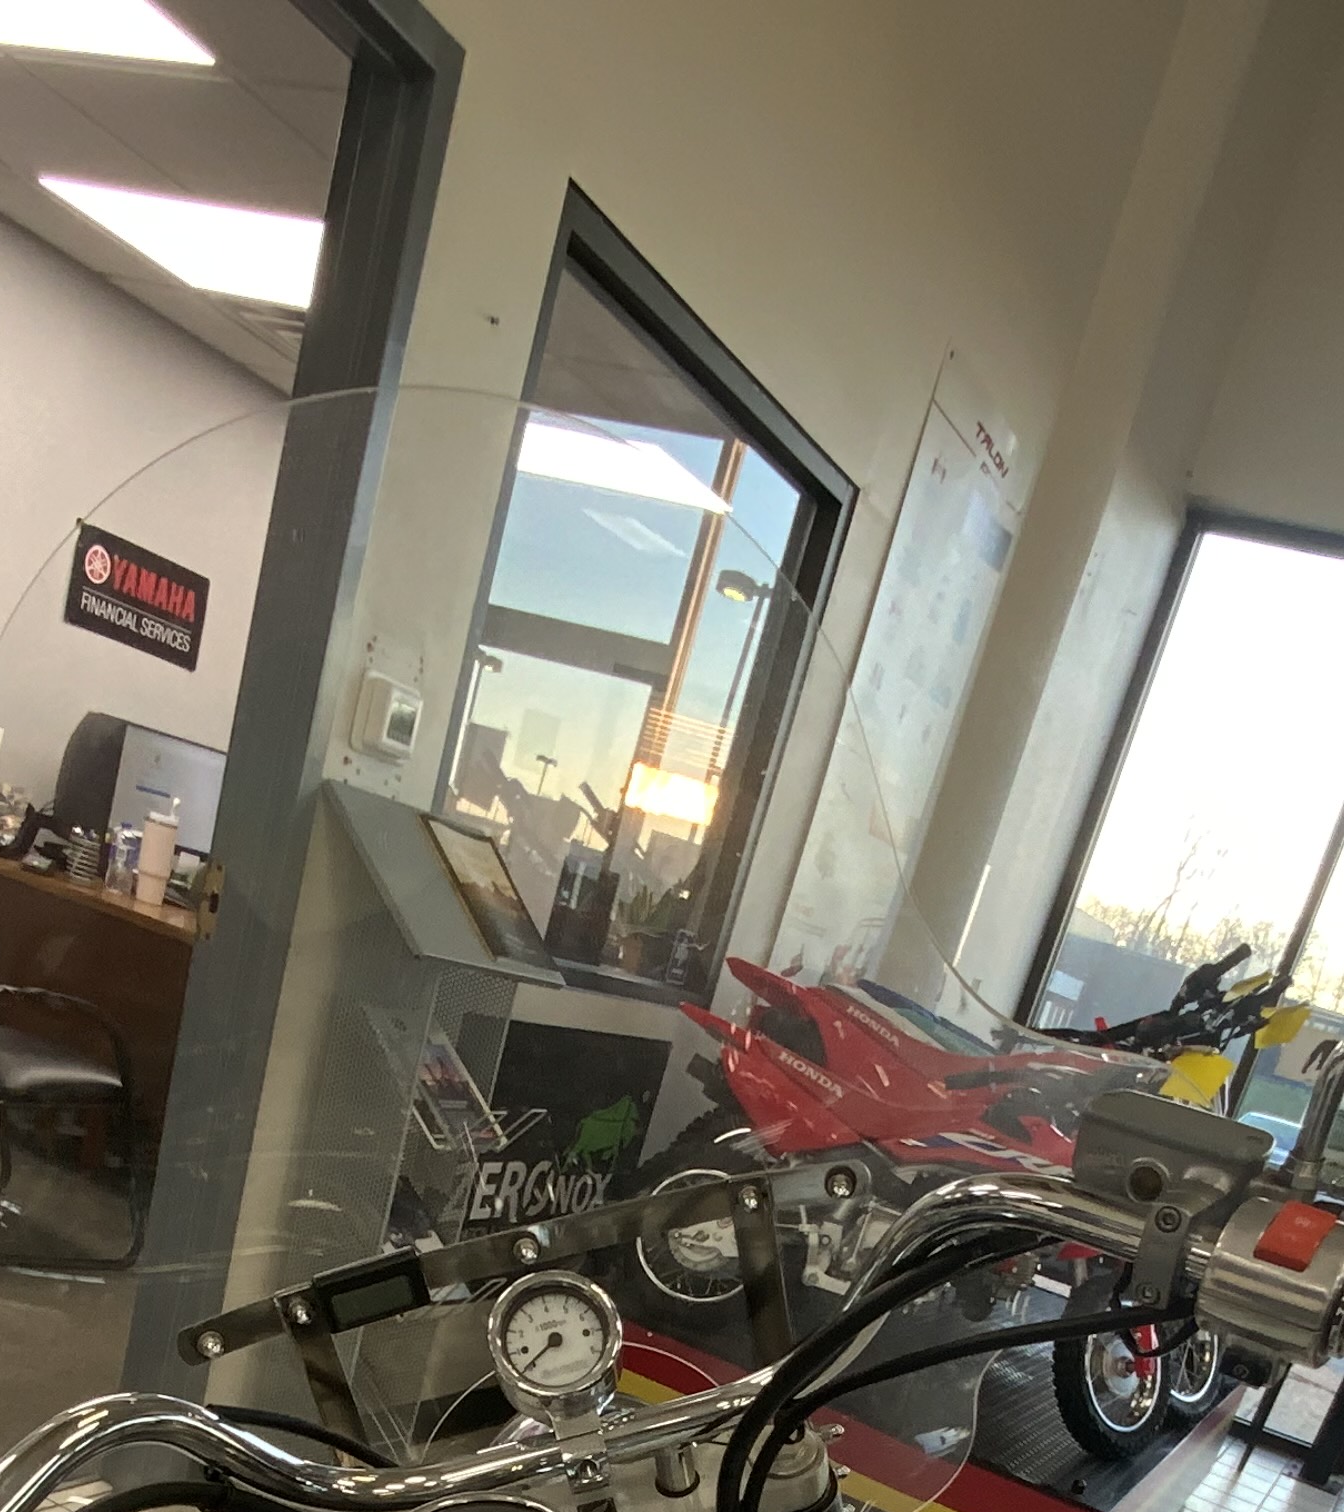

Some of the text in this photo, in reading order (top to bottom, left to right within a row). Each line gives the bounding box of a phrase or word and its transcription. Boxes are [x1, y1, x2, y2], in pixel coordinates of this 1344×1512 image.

[975, 420, 1009, 479] TALON
[112, 553, 196, 623] YAMAHA
[80, 591, 192, 653] FINANCIAL SERVICES
[846, 1005, 900, 1048] HONDA
[778, 1051, 844, 1099] HONDA
